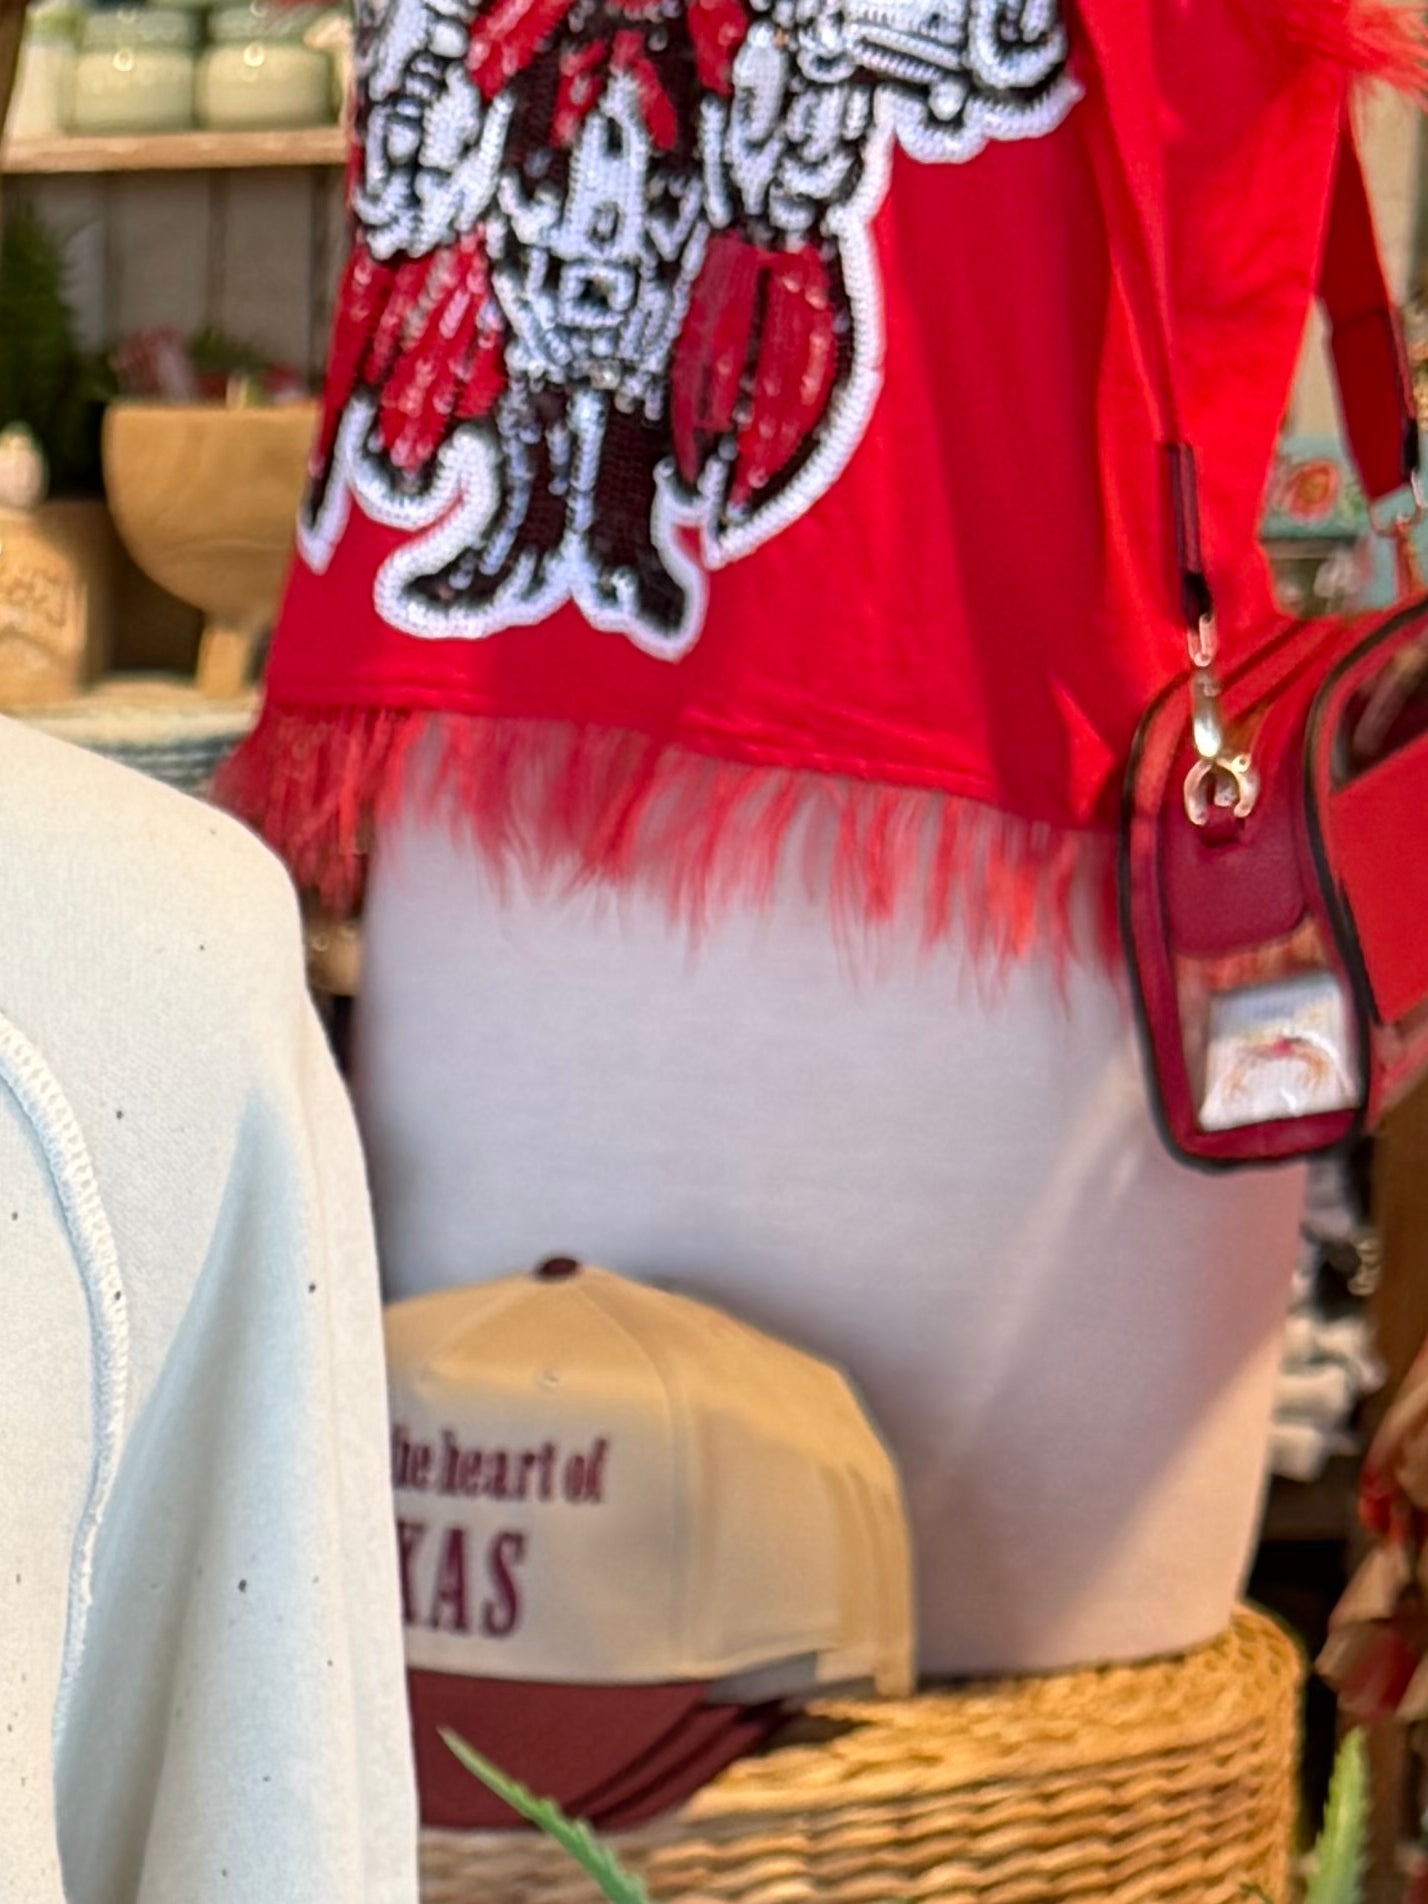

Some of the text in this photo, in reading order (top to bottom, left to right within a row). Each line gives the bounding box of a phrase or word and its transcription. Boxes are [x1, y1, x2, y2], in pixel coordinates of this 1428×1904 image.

[390, 1425, 608, 1503] he heart of
[396, 1518, 525, 1637] XAS
